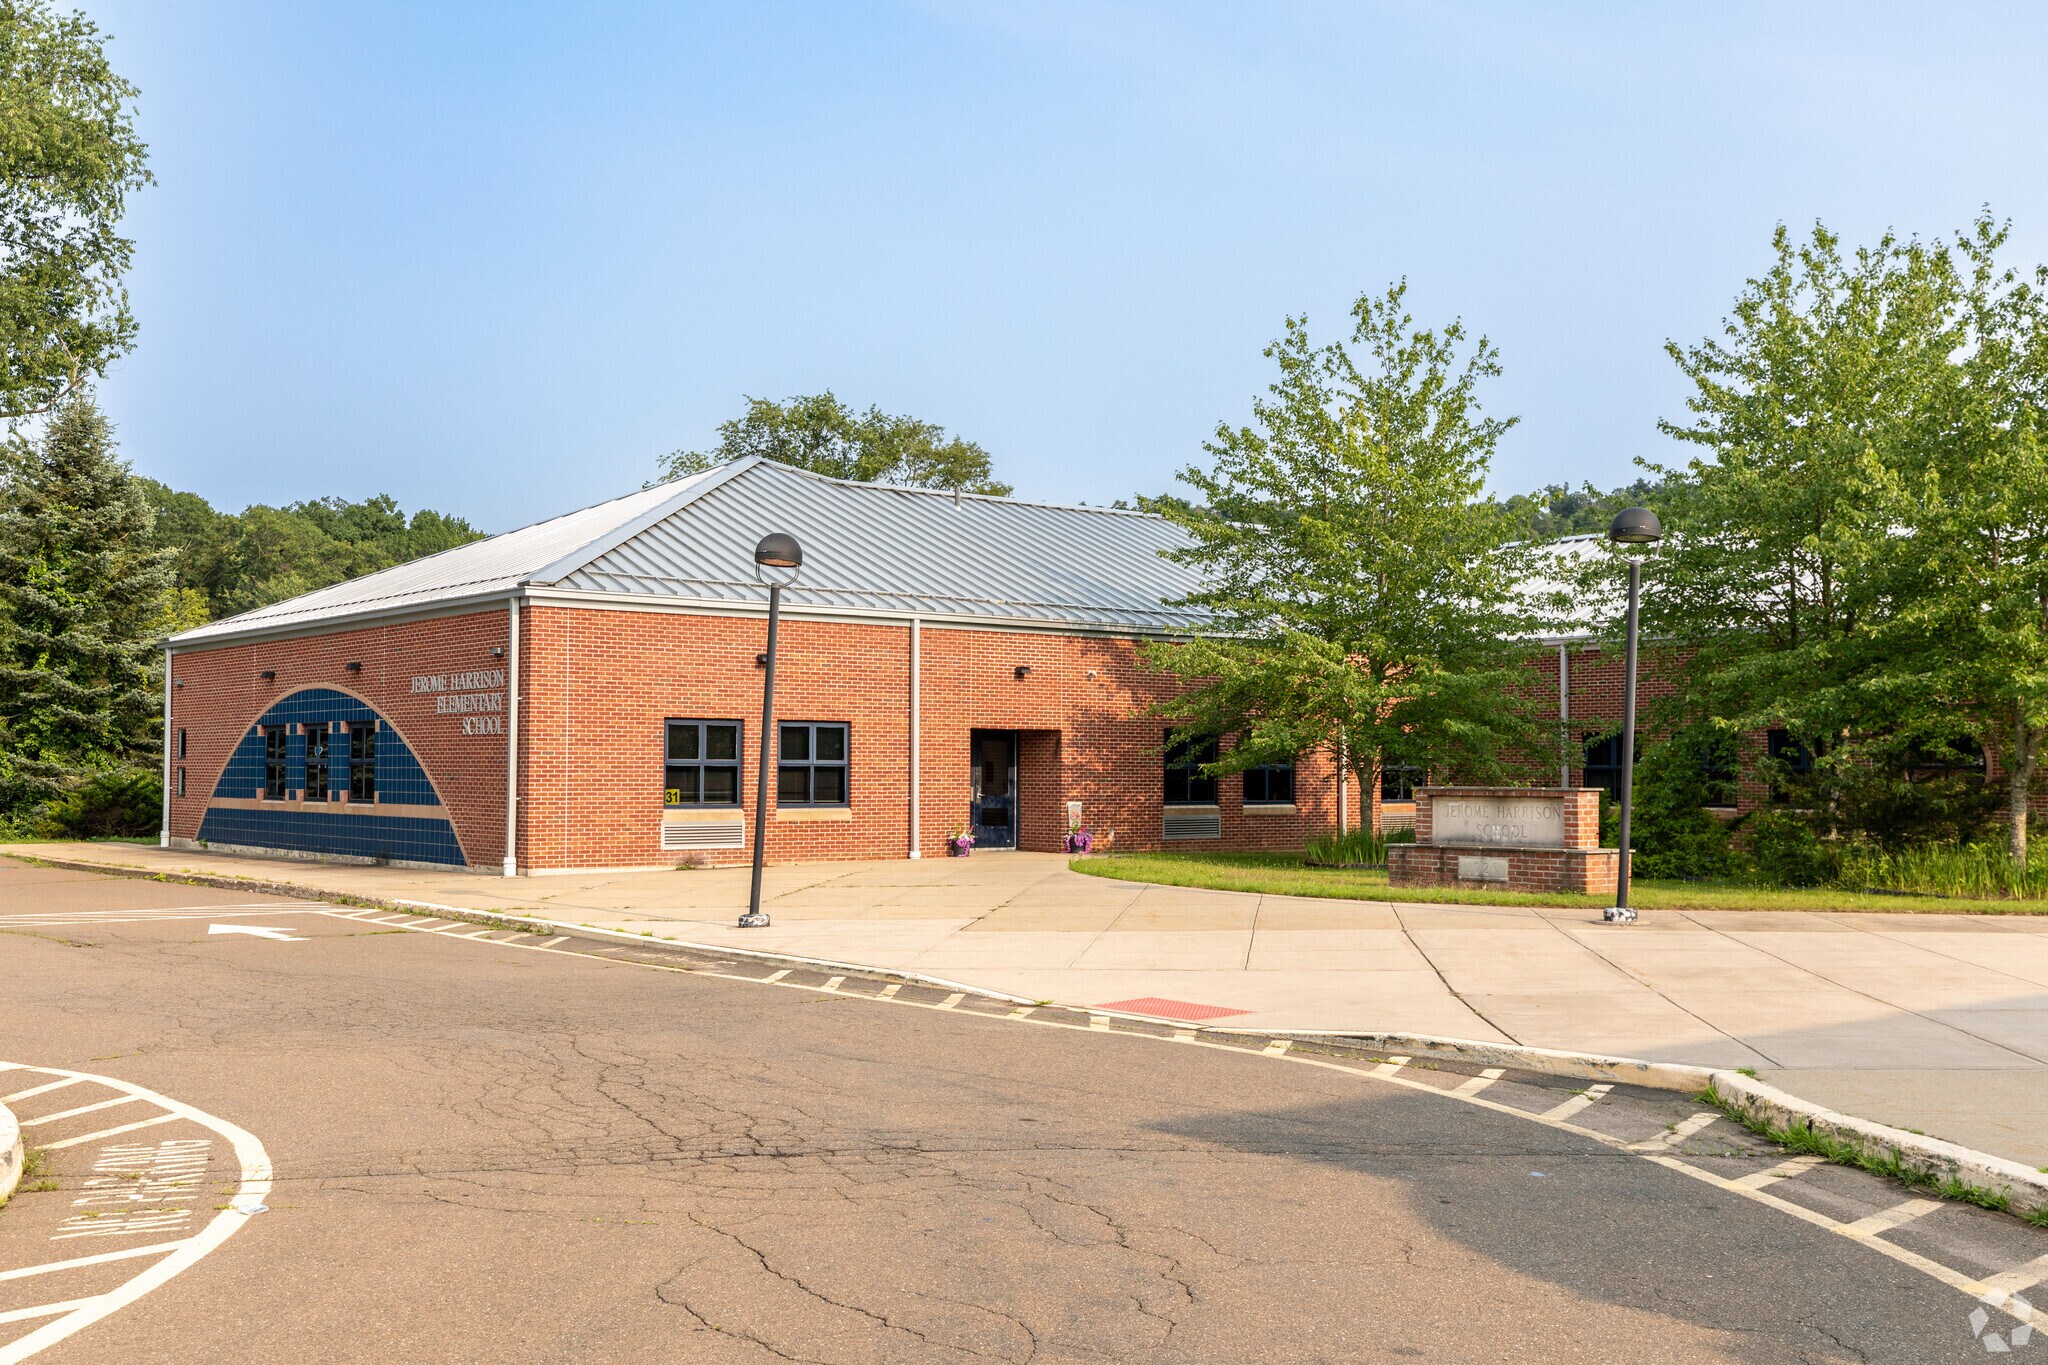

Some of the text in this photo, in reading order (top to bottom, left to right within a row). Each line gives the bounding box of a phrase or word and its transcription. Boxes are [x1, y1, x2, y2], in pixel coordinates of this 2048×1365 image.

[411, 669, 504, 693] JEROME HARRISON
[436, 693, 504, 714] ELEMENTARY
[462, 716, 503, 735] SCHOOL
[666, 791, 678, 803] 31
[1444, 804, 1561, 821] JEROME HARRISON
[1476, 823, 1528, 839] SCHOOL
